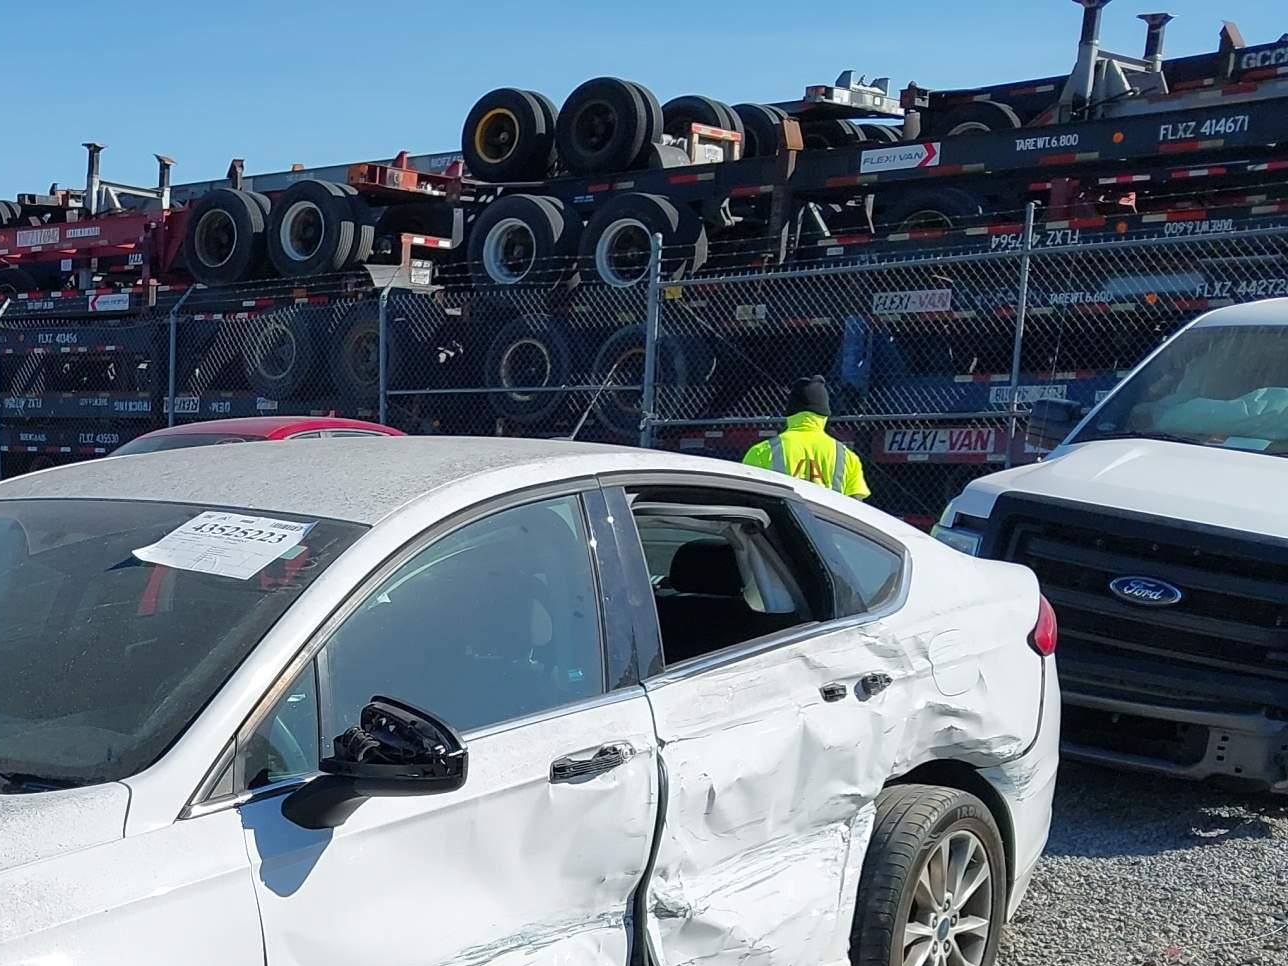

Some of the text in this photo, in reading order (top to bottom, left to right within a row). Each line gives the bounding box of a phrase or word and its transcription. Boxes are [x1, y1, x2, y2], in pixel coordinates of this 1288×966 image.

[1160, 115, 1249, 141] FLXZ 414671
[991, 229, 1080, 249] FLXZ 47564
[1196, 278, 1288, 297] FLXZ 44272
[888, 429, 992, 451] FLEXI-VAN
[192, 522, 287, 544] 43525223
[1123, 580, 1164, 600] Ford
